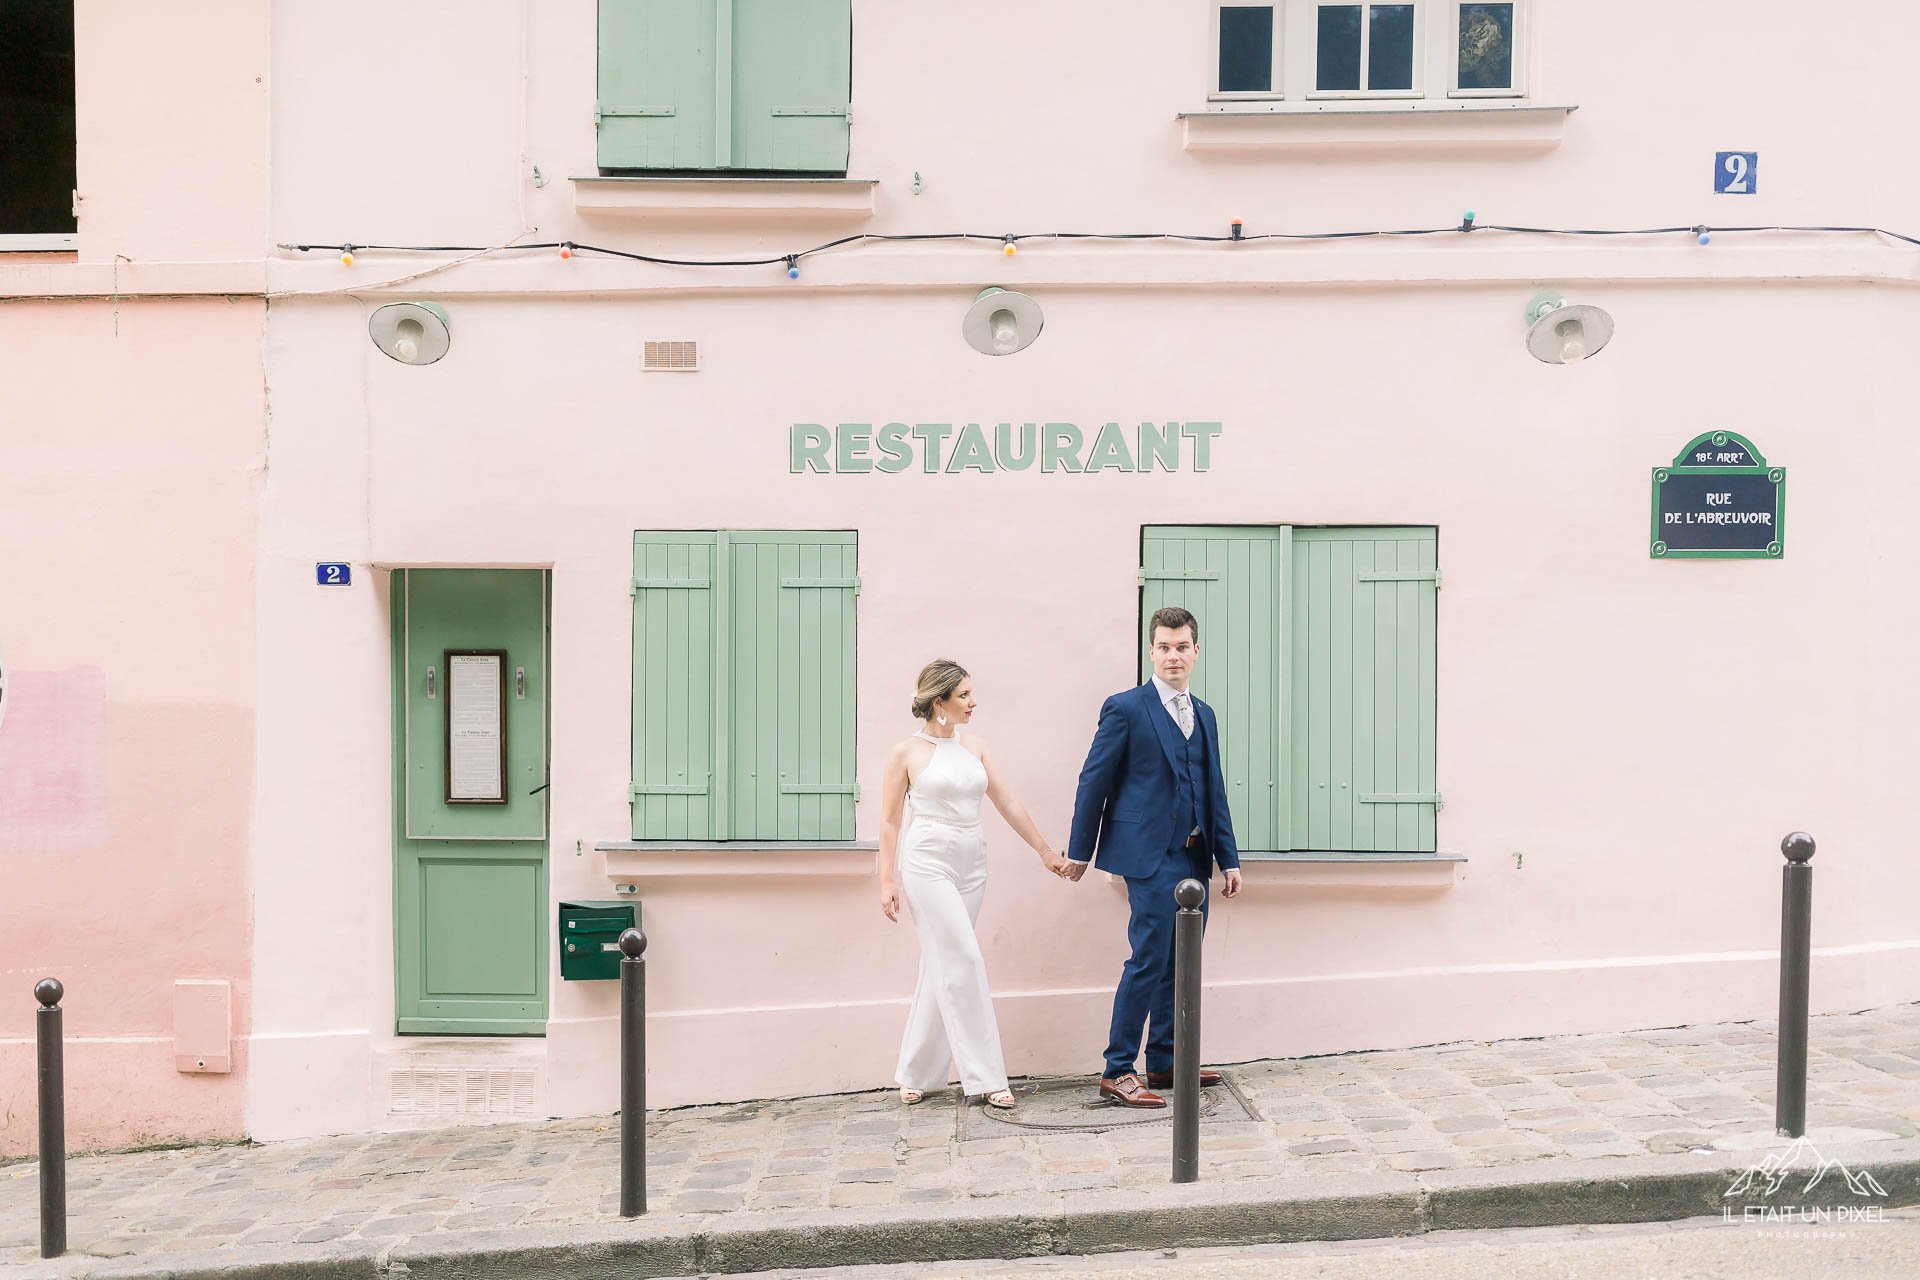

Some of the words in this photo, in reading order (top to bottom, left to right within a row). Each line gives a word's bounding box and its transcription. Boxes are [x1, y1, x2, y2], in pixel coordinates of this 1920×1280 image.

[1724, 154, 1748, 192] 2
[789, 421, 1223, 474] RESTAURANT
[1706, 492, 1732, 507] RUE
[1664, 512, 1682, 524] DE
[1686, 512, 1772, 526] L'ABREUVOIR
[326, 565, 340, 583] 2
